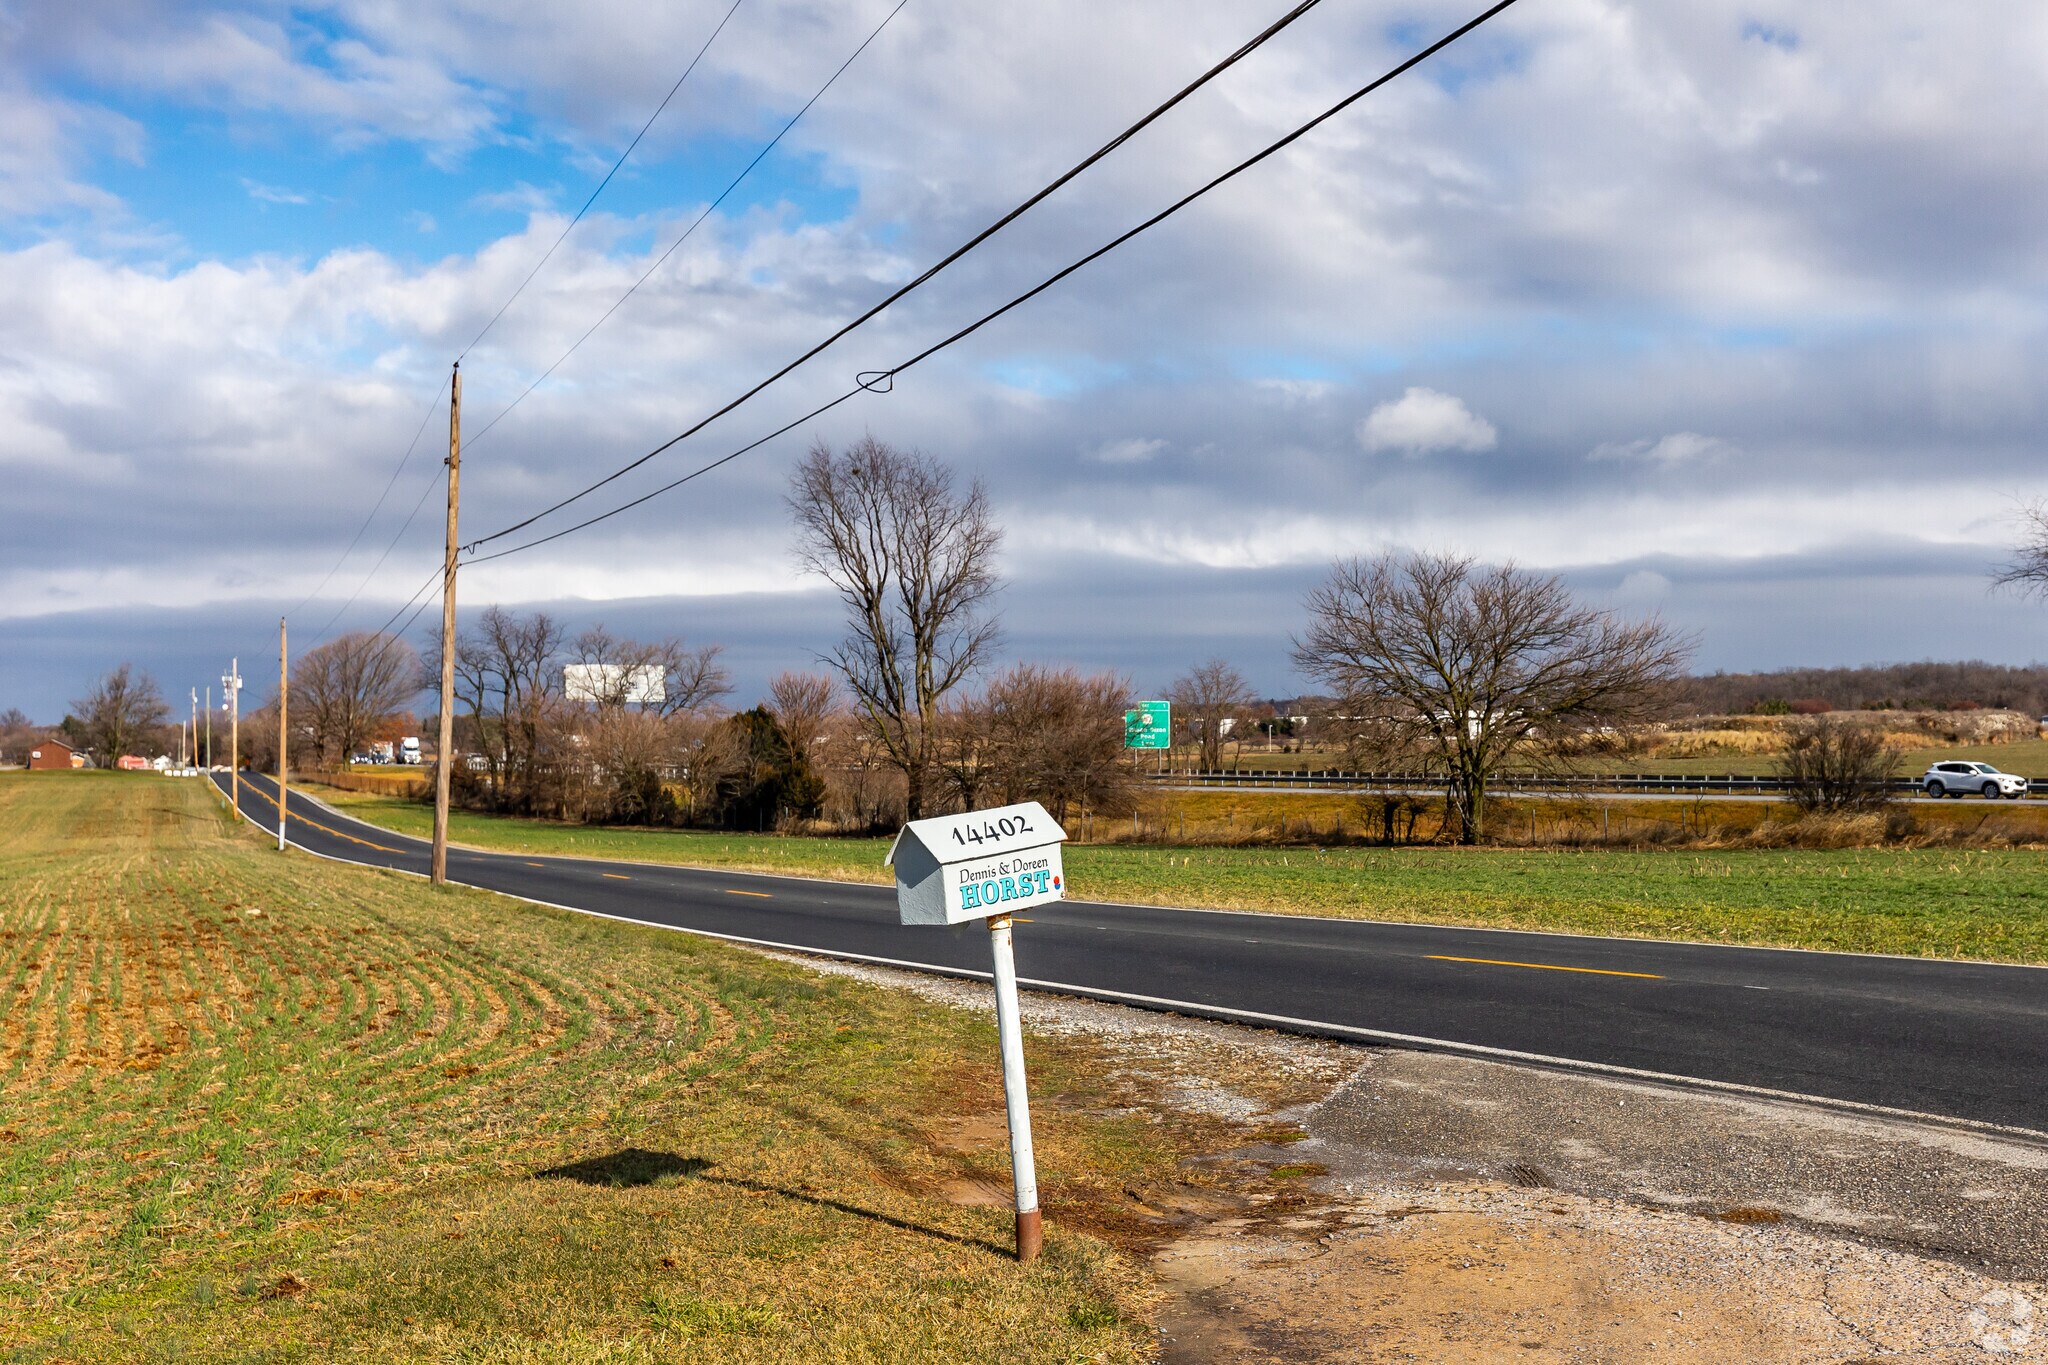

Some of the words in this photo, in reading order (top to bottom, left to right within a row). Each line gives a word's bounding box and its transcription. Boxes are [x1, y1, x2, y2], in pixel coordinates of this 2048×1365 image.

[952, 815, 1033, 846] 14402
[959, 865, 997, 884] Dennis
[999, 862, 1011, 876] &
[1012, 858, 1049, 873] Doreen
[959, 869, 1050, 909] HORST
